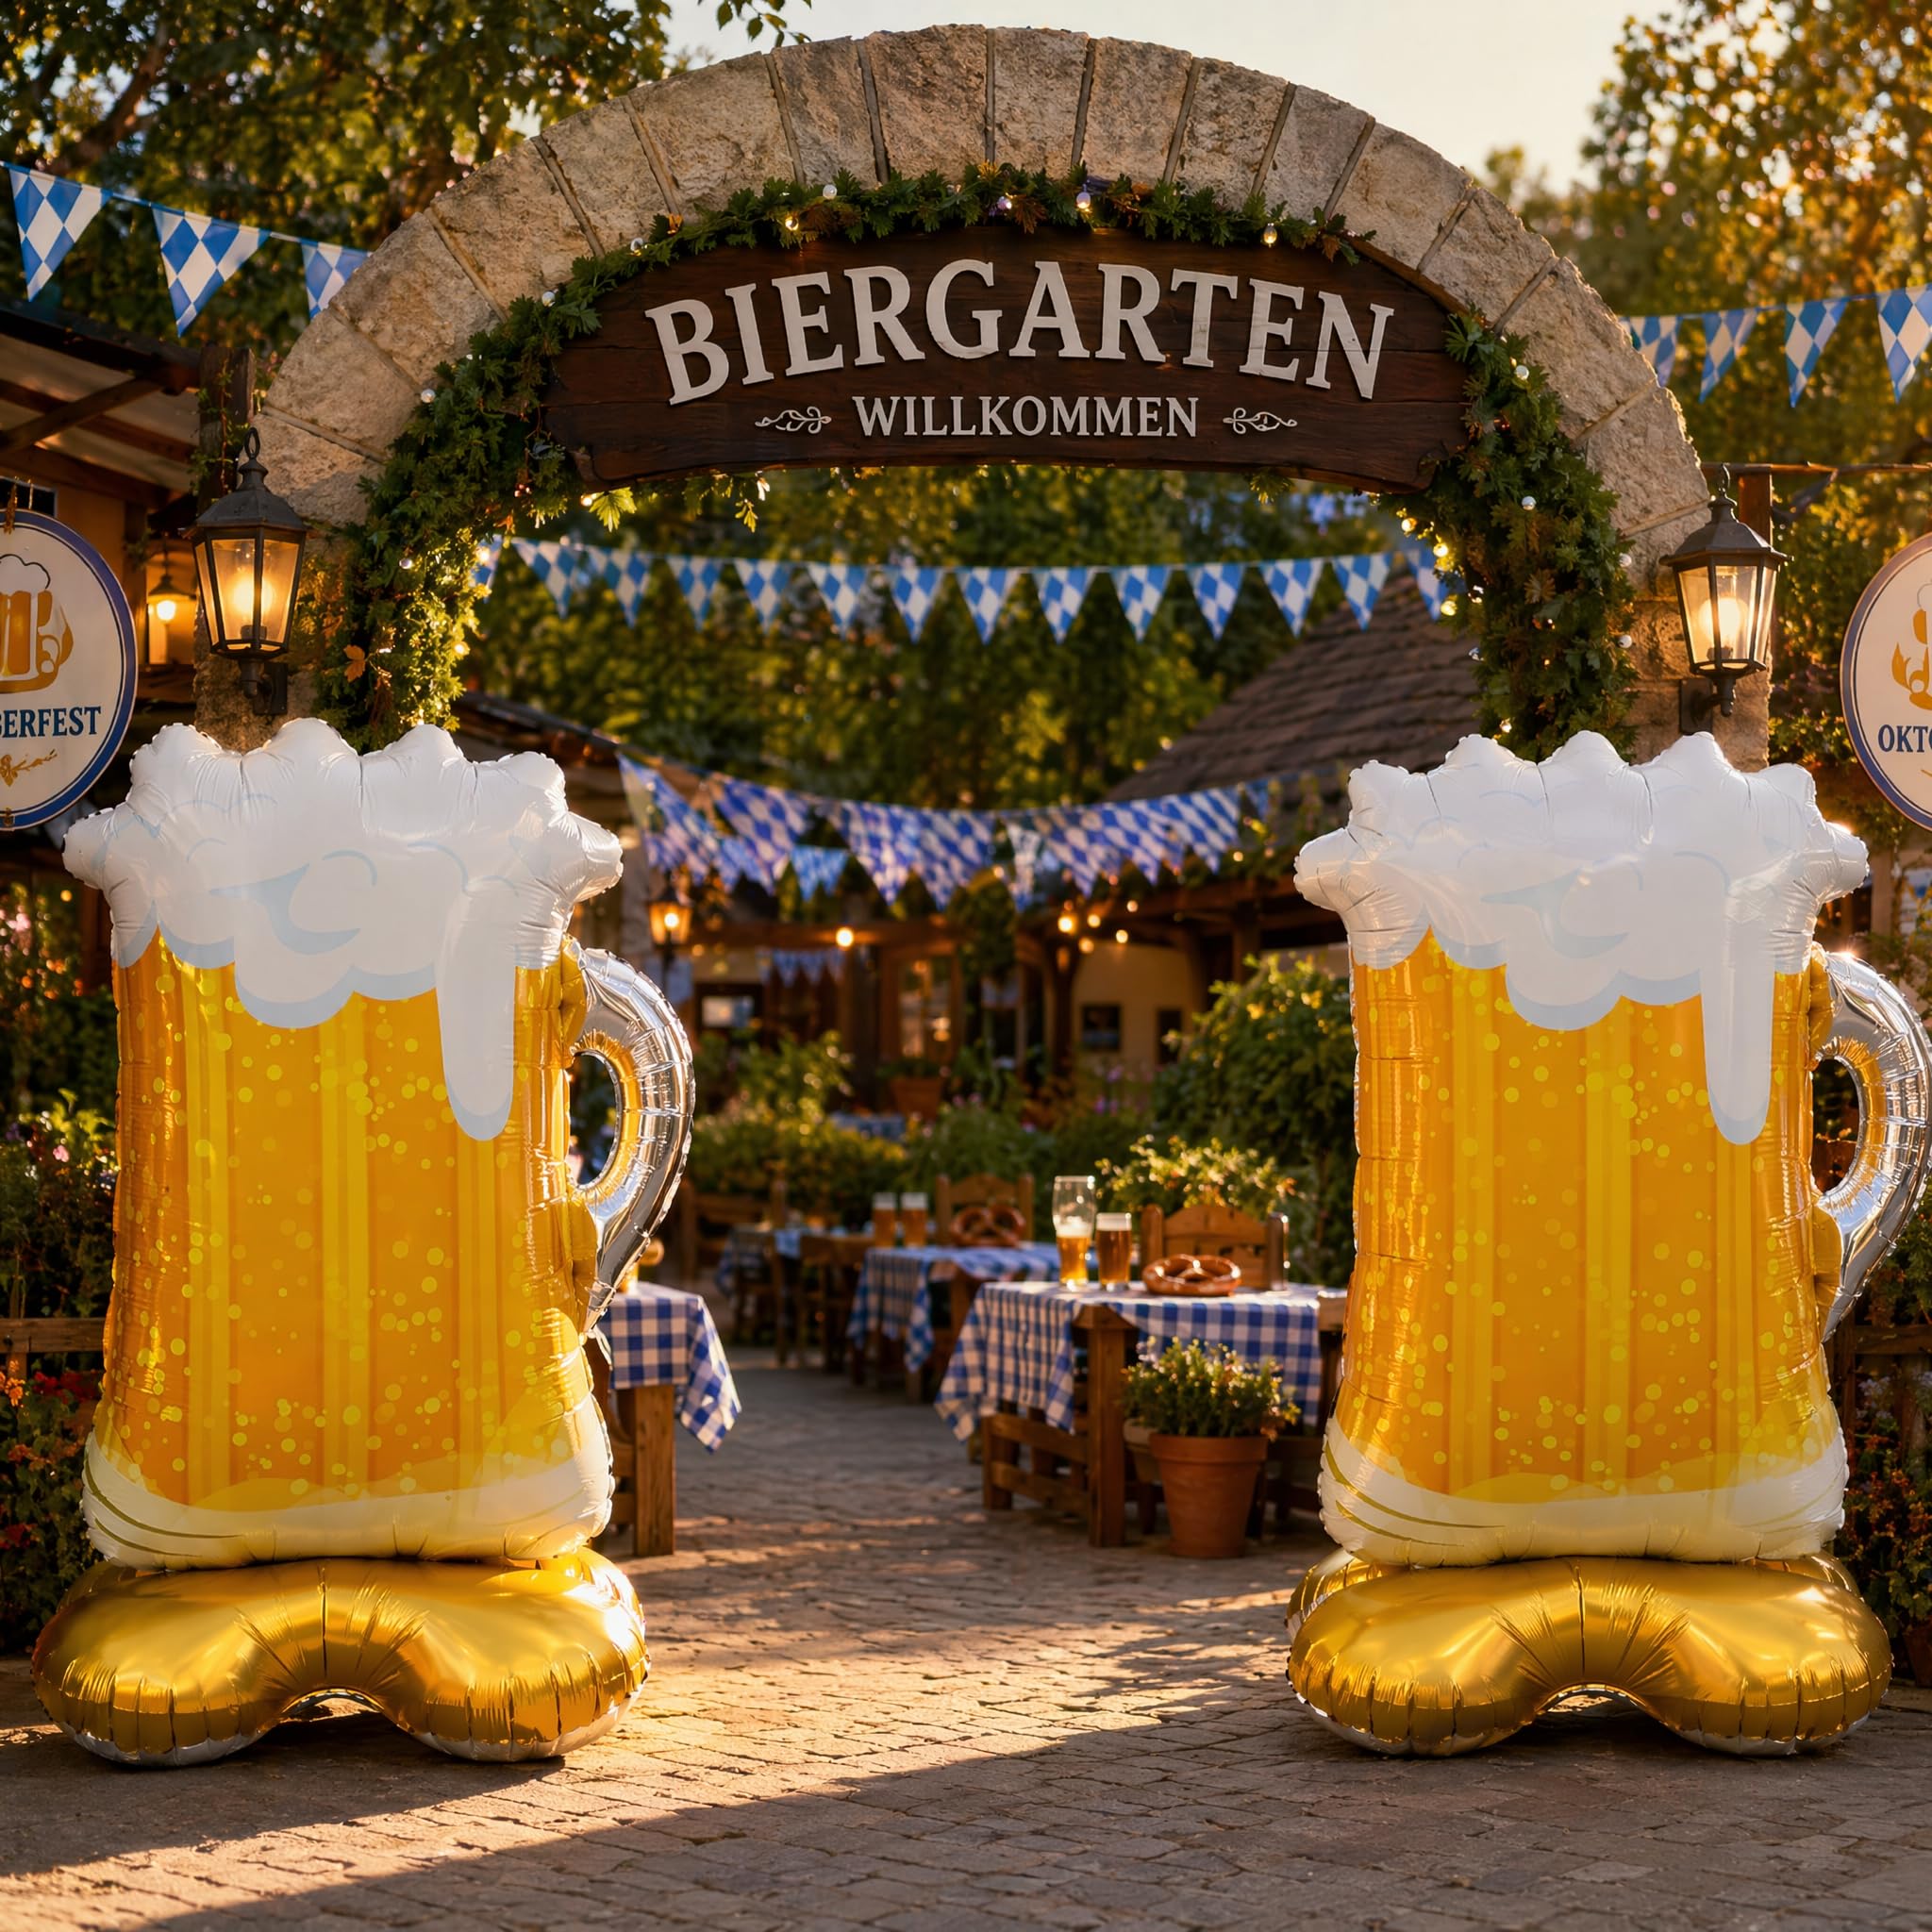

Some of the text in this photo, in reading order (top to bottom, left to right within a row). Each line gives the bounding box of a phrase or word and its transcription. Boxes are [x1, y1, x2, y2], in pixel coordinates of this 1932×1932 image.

[645, 259, 1395, 406] BIERGARTEN
[853, 395, 1199, 437] WILLKOMMEN
[0, 706, 101, 738] ERFEST
[1878, 724, 1932, 753] OKT
